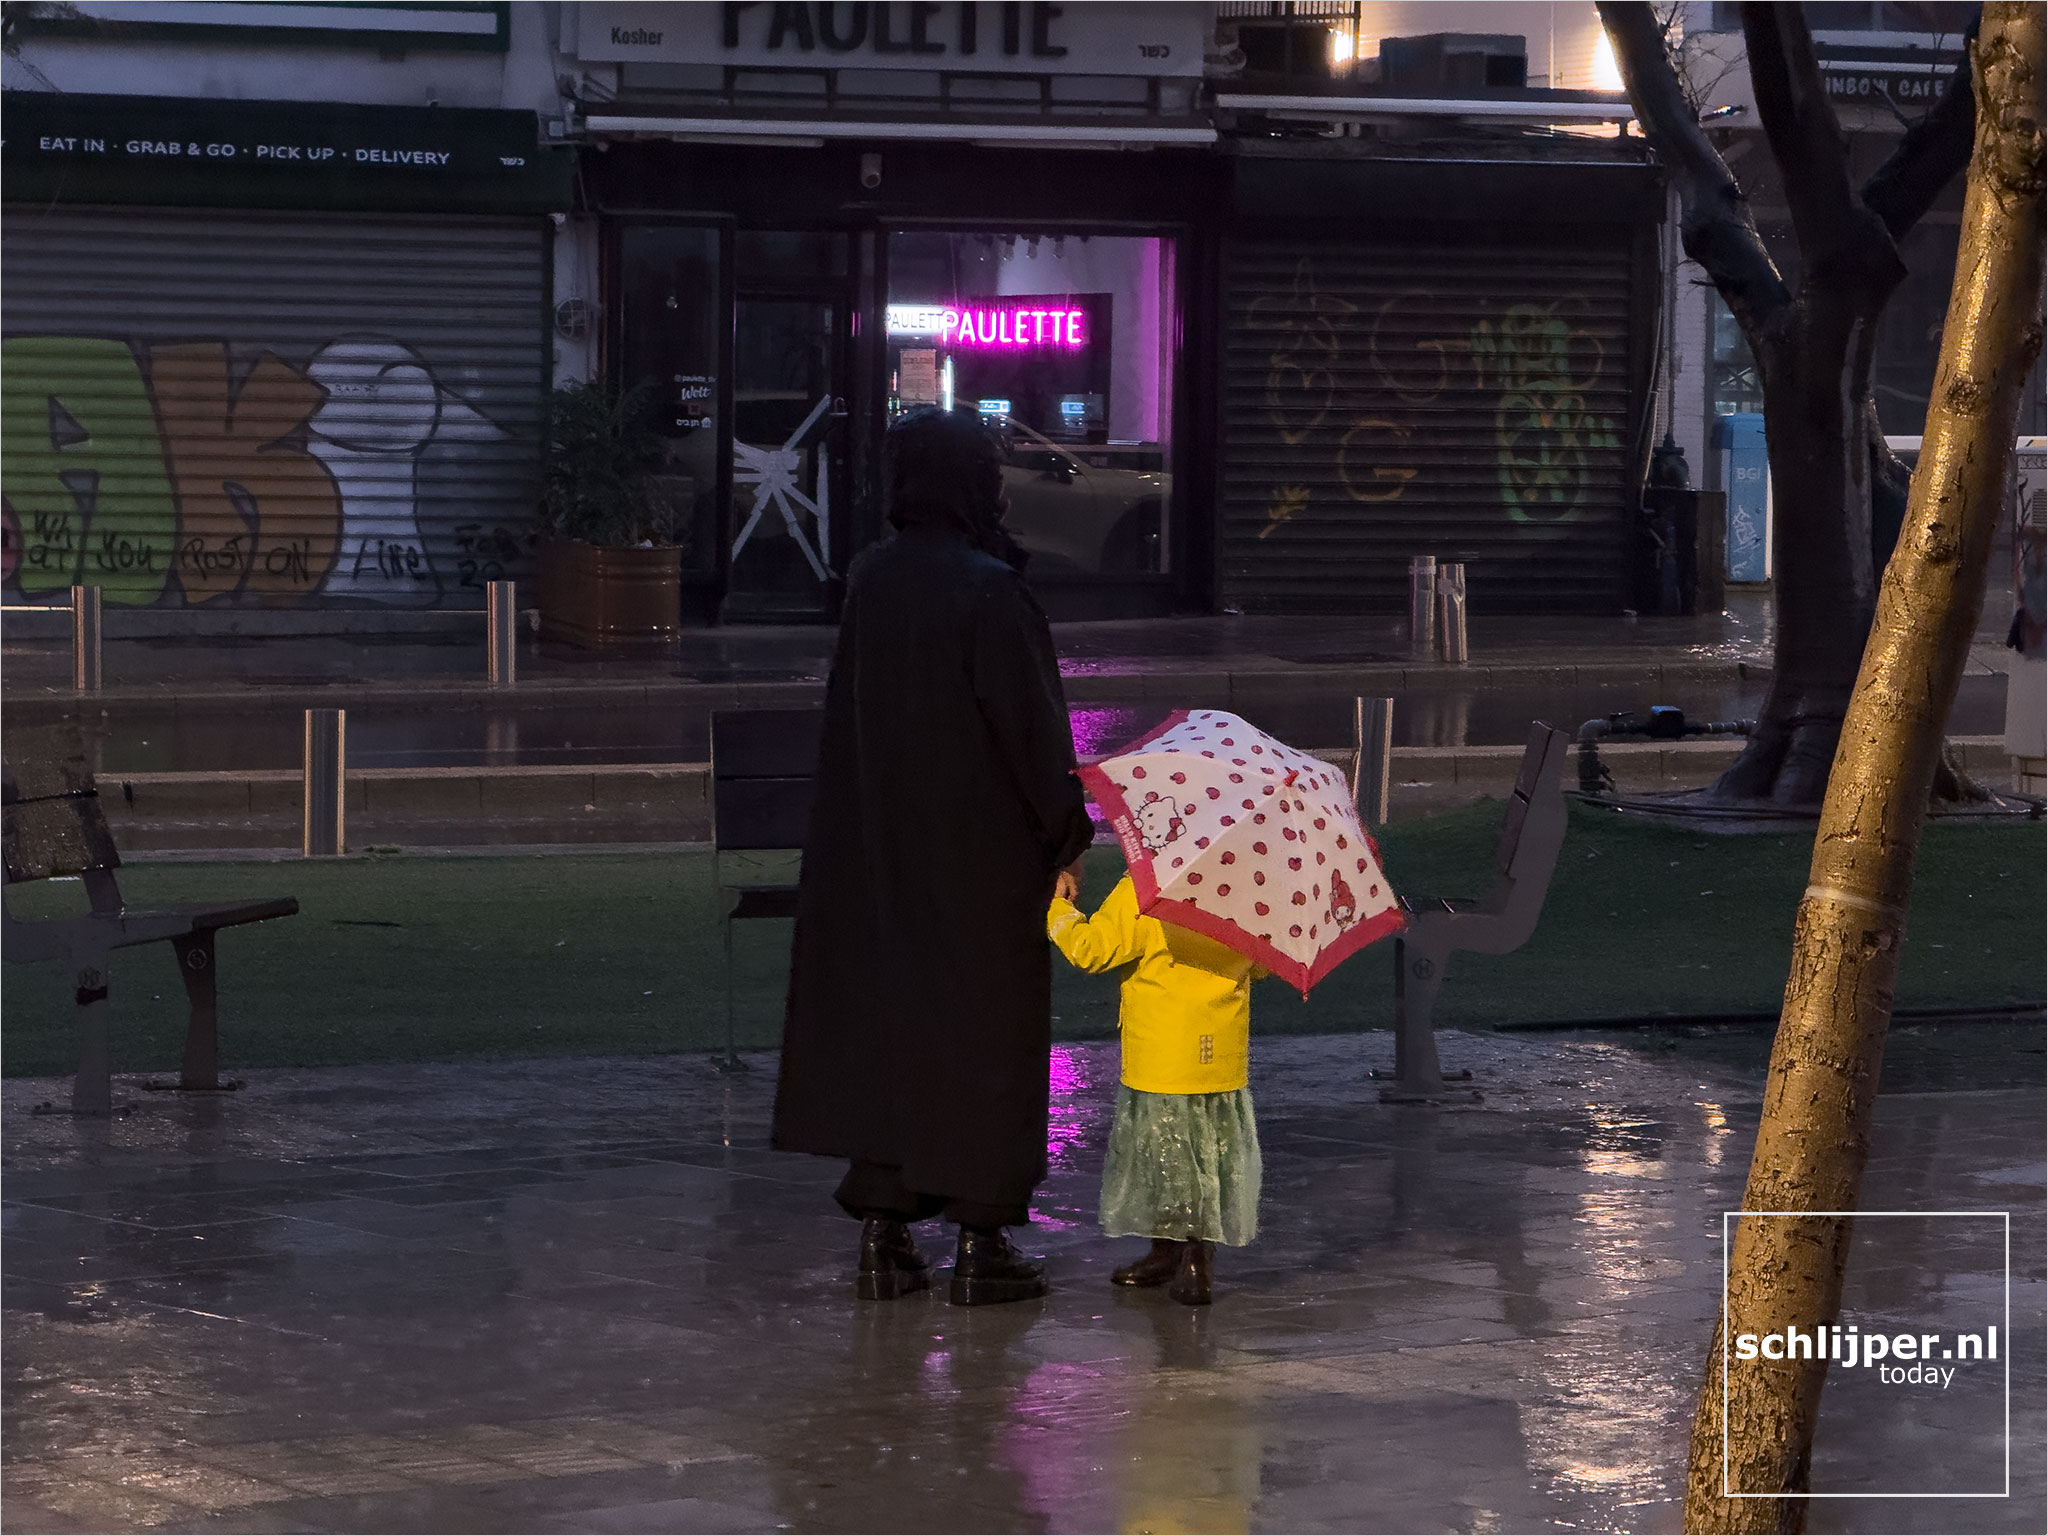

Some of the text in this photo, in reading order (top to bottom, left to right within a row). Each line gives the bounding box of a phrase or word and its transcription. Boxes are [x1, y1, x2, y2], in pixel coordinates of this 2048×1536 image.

[611, 27, 663, 45] Kosher
[1138, 44, 1170, 59] כשר
[1898, 79, 1945, 97] CAFE
[39, 136, 449, 165] EAT IN GRAB & GO PICK UP DELIVERY
[941, 310, 1083, 343] PAULETTE
